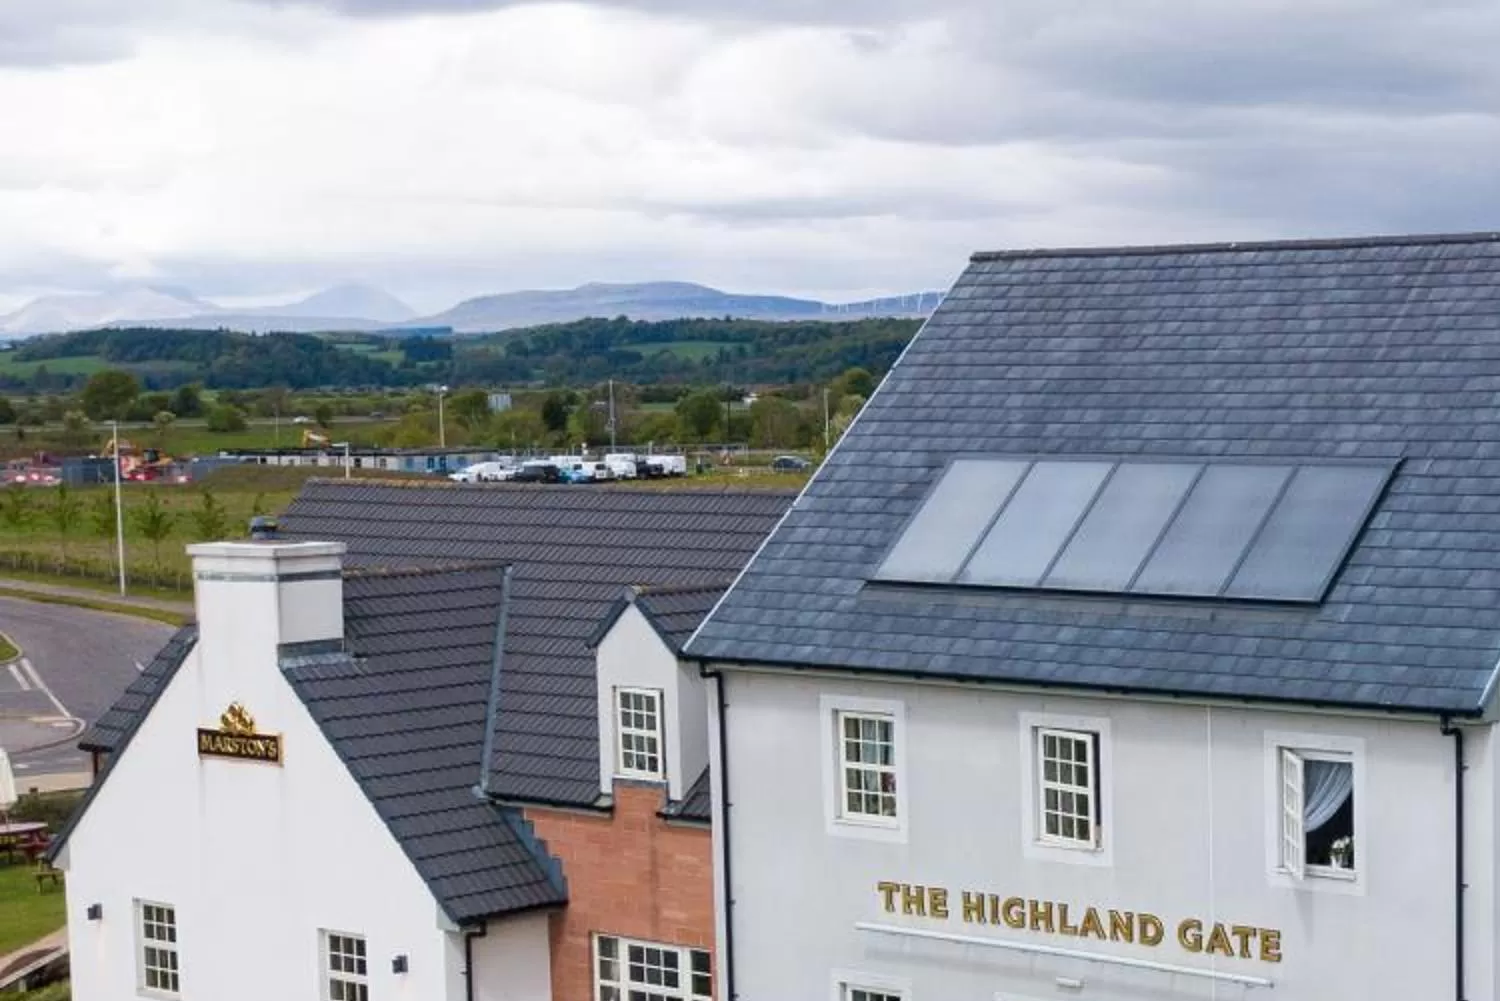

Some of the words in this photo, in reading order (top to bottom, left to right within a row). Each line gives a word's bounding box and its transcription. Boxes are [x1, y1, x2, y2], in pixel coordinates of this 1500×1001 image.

[877, 881, 949, 918] THE
[962, 891, 1165, 947] HIGHLAND
[1177, 918, 1283, 963] GATE
